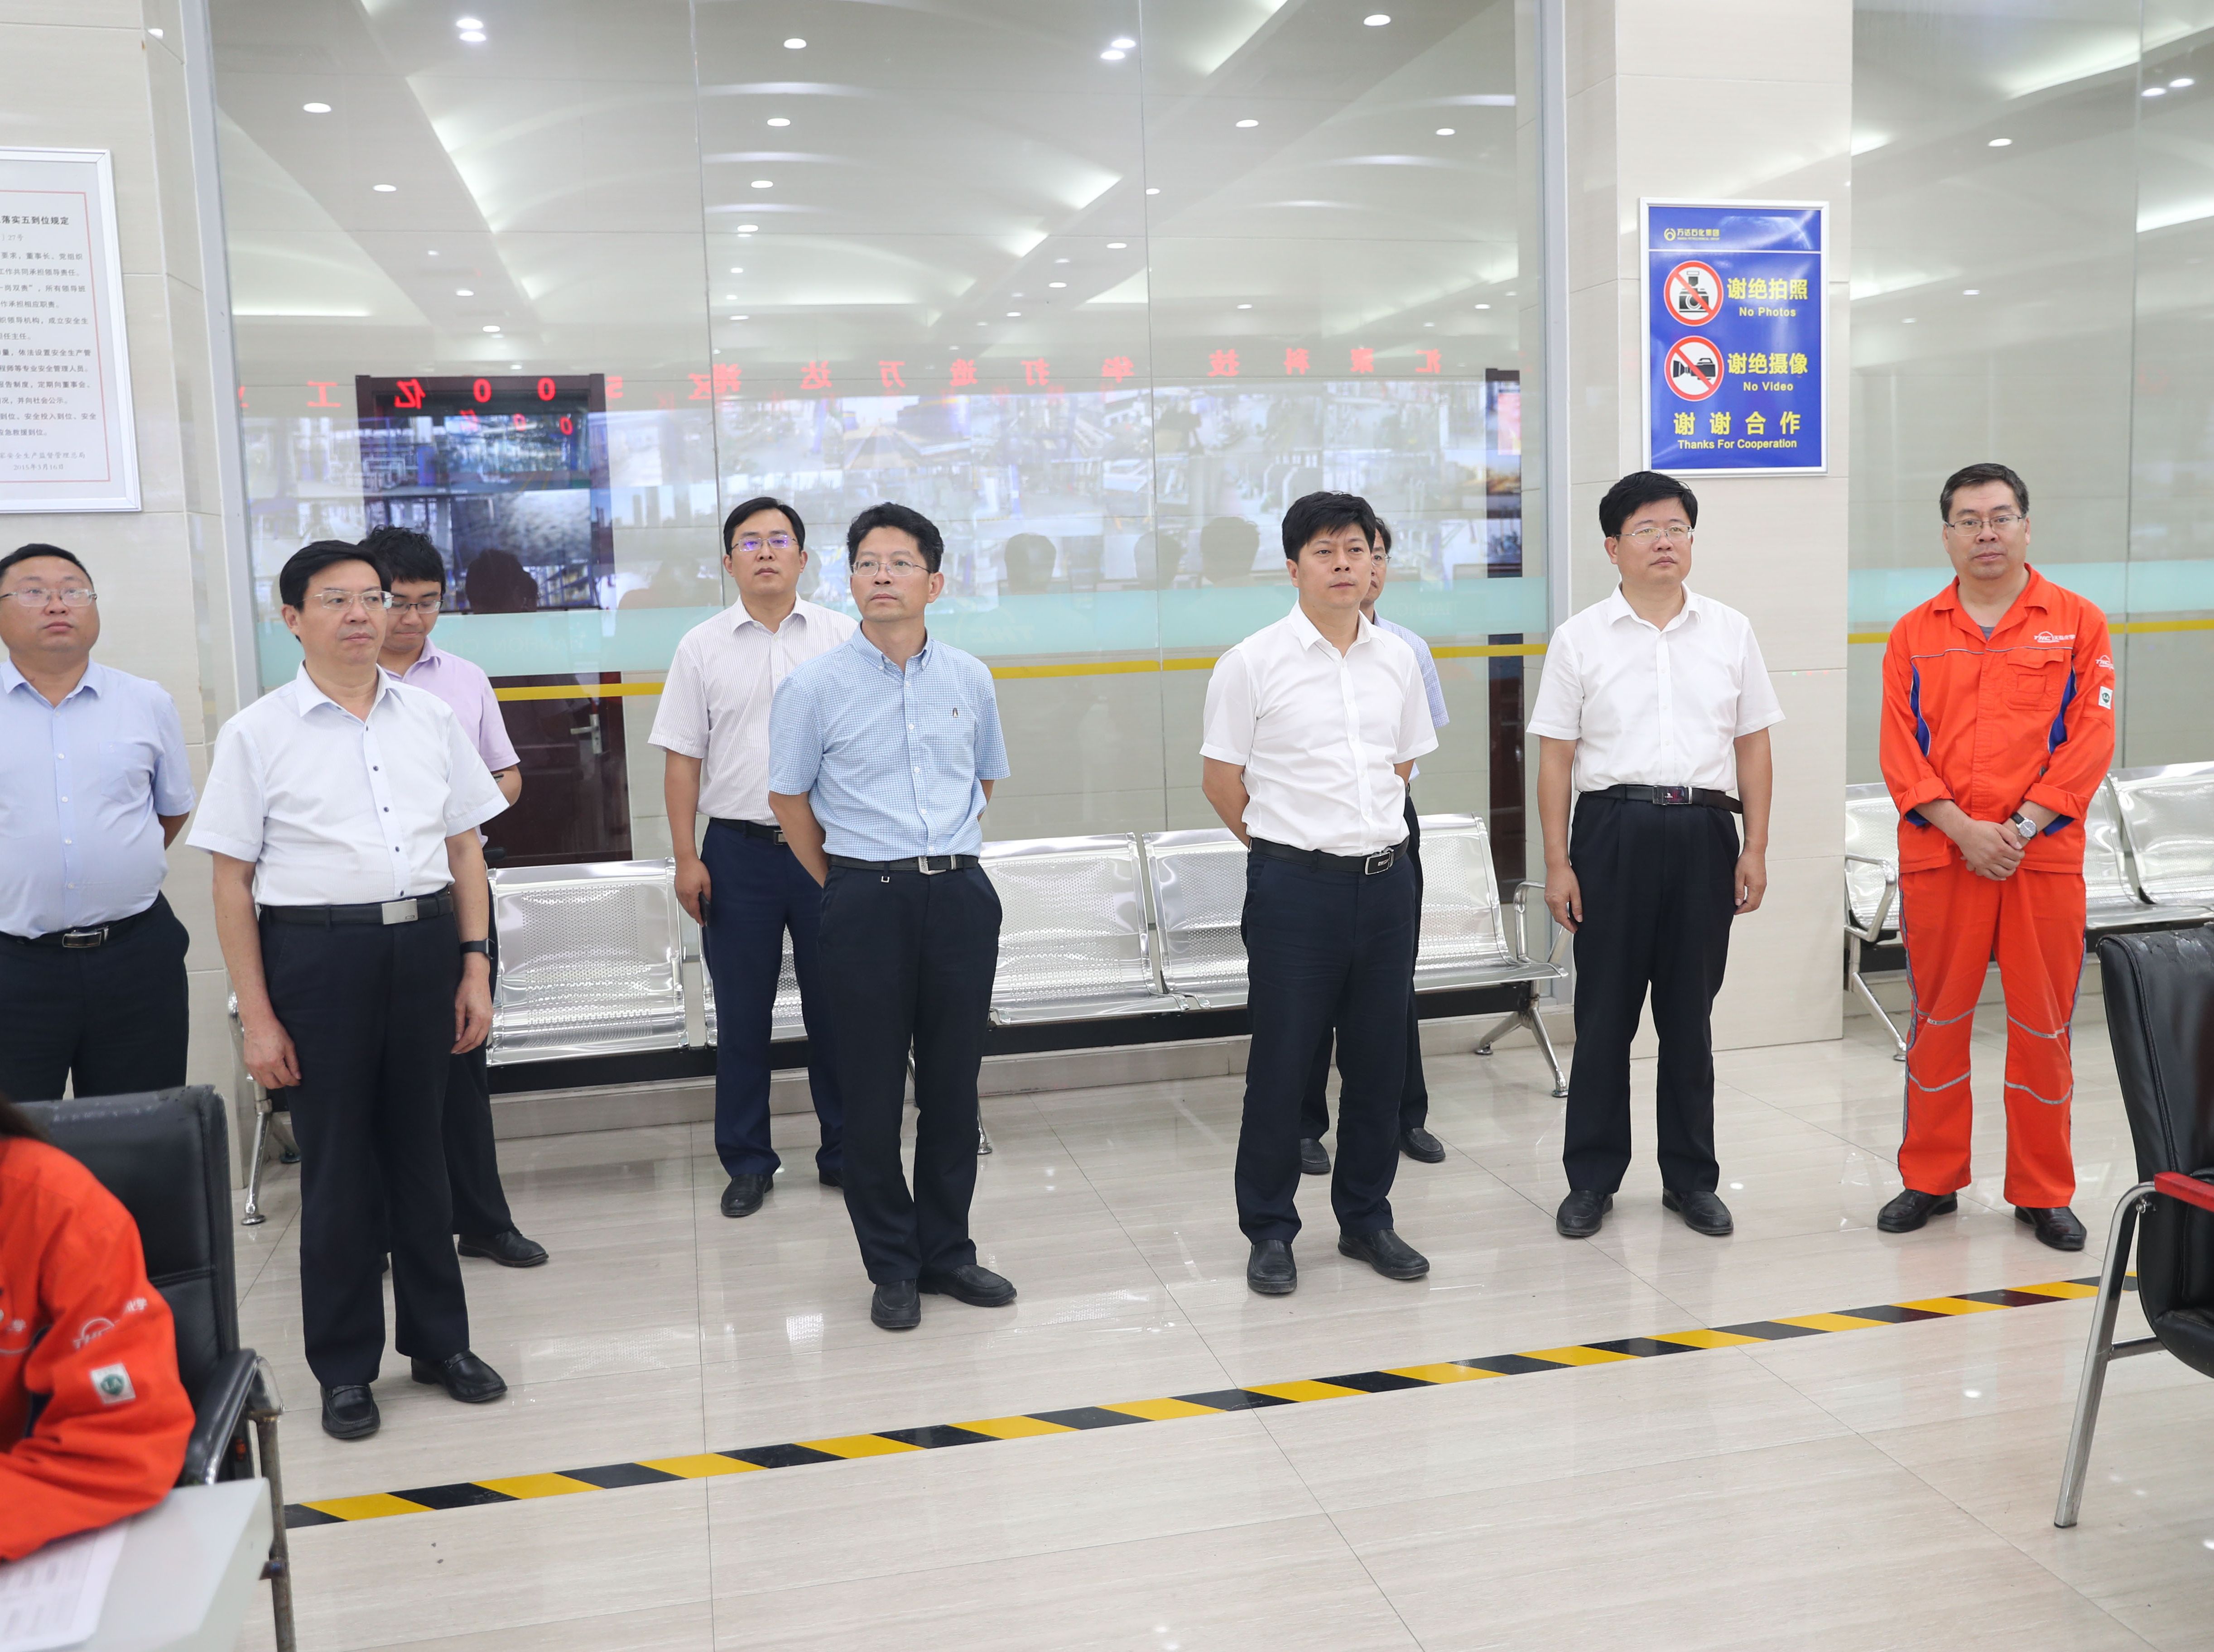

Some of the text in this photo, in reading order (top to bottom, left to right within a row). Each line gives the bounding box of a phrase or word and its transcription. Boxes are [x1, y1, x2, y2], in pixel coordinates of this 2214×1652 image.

[0, 215, 69, 226] 落实五到位规定
[1727, 278, 1808, 301] 谢绝拍照
[1739, 307, 1796, 317] No Photos
[0, 349, 91, 357] 量，依法设置安全生产管
[1727, 353, 1808, 375] 谢绝摄像
[1743, 382, 1794, 391] No Video
[1674, 412, 1801, 435] 谢谢合作
[1678, 439, 1797, 450] Thanks For Cooperation
